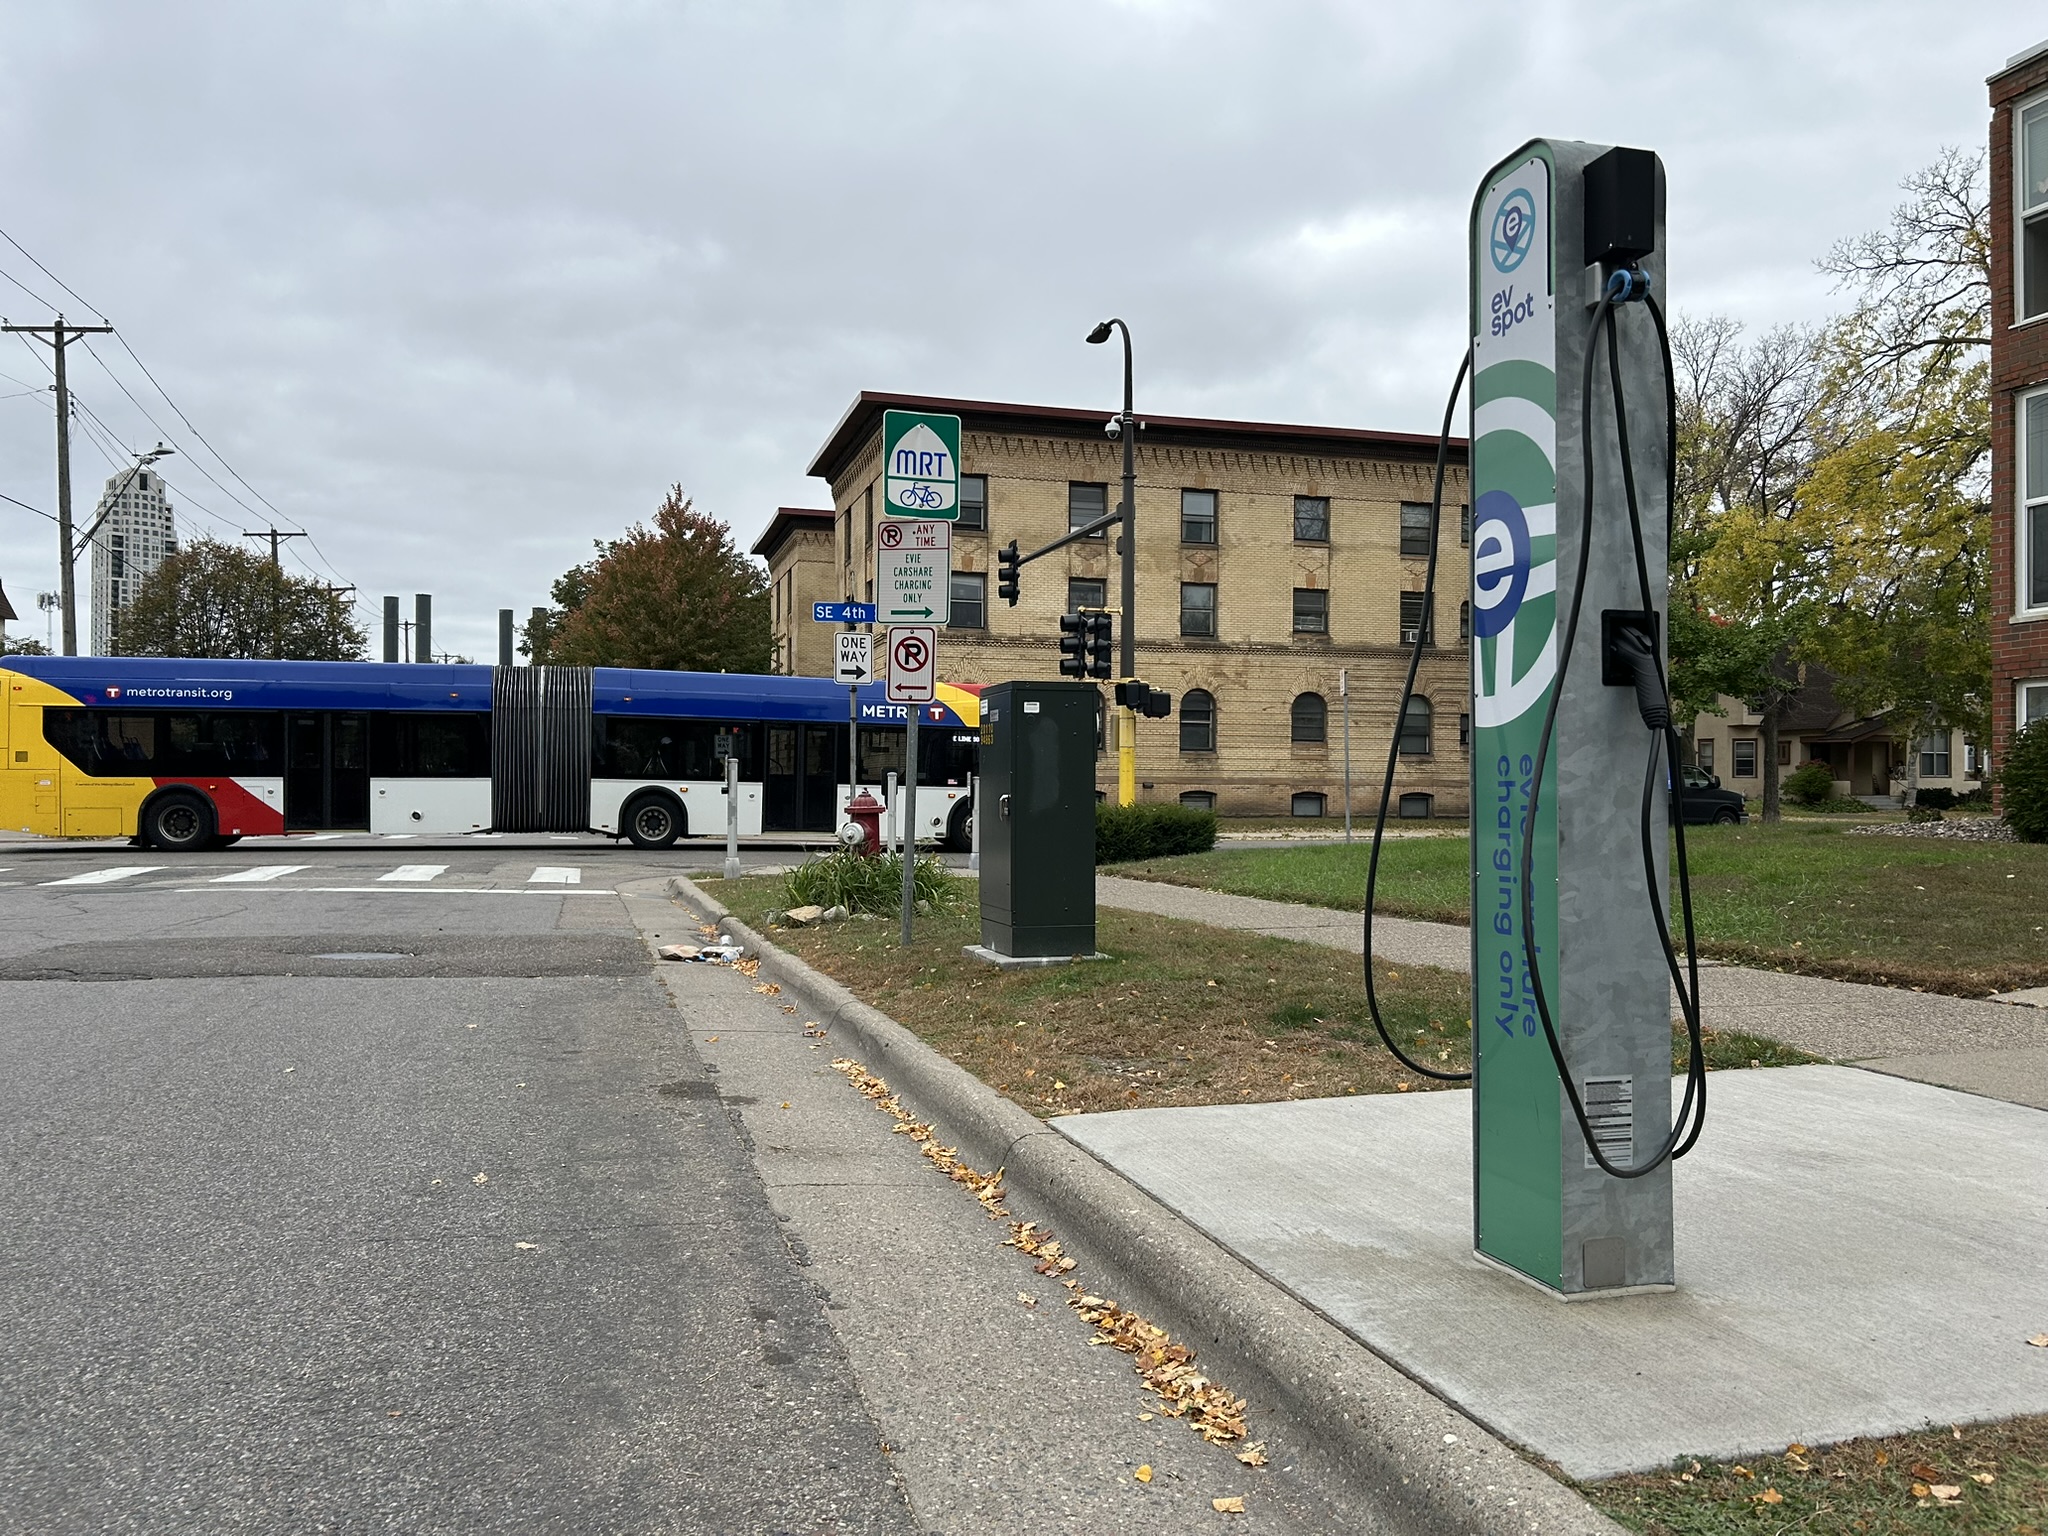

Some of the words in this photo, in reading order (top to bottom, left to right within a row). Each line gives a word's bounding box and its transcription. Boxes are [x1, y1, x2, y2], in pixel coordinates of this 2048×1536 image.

[1491, 284, 1513, 315] ev
[1491, 293, 1534, 337] spot
[896, 449, 947, 477] MRT
[916, 524, 935, 534] ANY
[915, 537, 936, 546] TIME
[905, 554, 921, 563] EVIE
[893, 567, 933, 577] CARSHARE
[894, 580, 932, 590] CHARGING
[903, 593, 923, 603] ONLY
[816, 606, 833, 618] SE
[842, 606, 865, 619] 4th
[841, 637, 866, 649] ONE
[840, 651, 867, 662] WAY
[126, 688, 232, 700] metrotransit.org
[862, 705, 920, 718] METR
[1493, 755, 1516, 936] charging
[1495, 951, 1519, 1038] only
